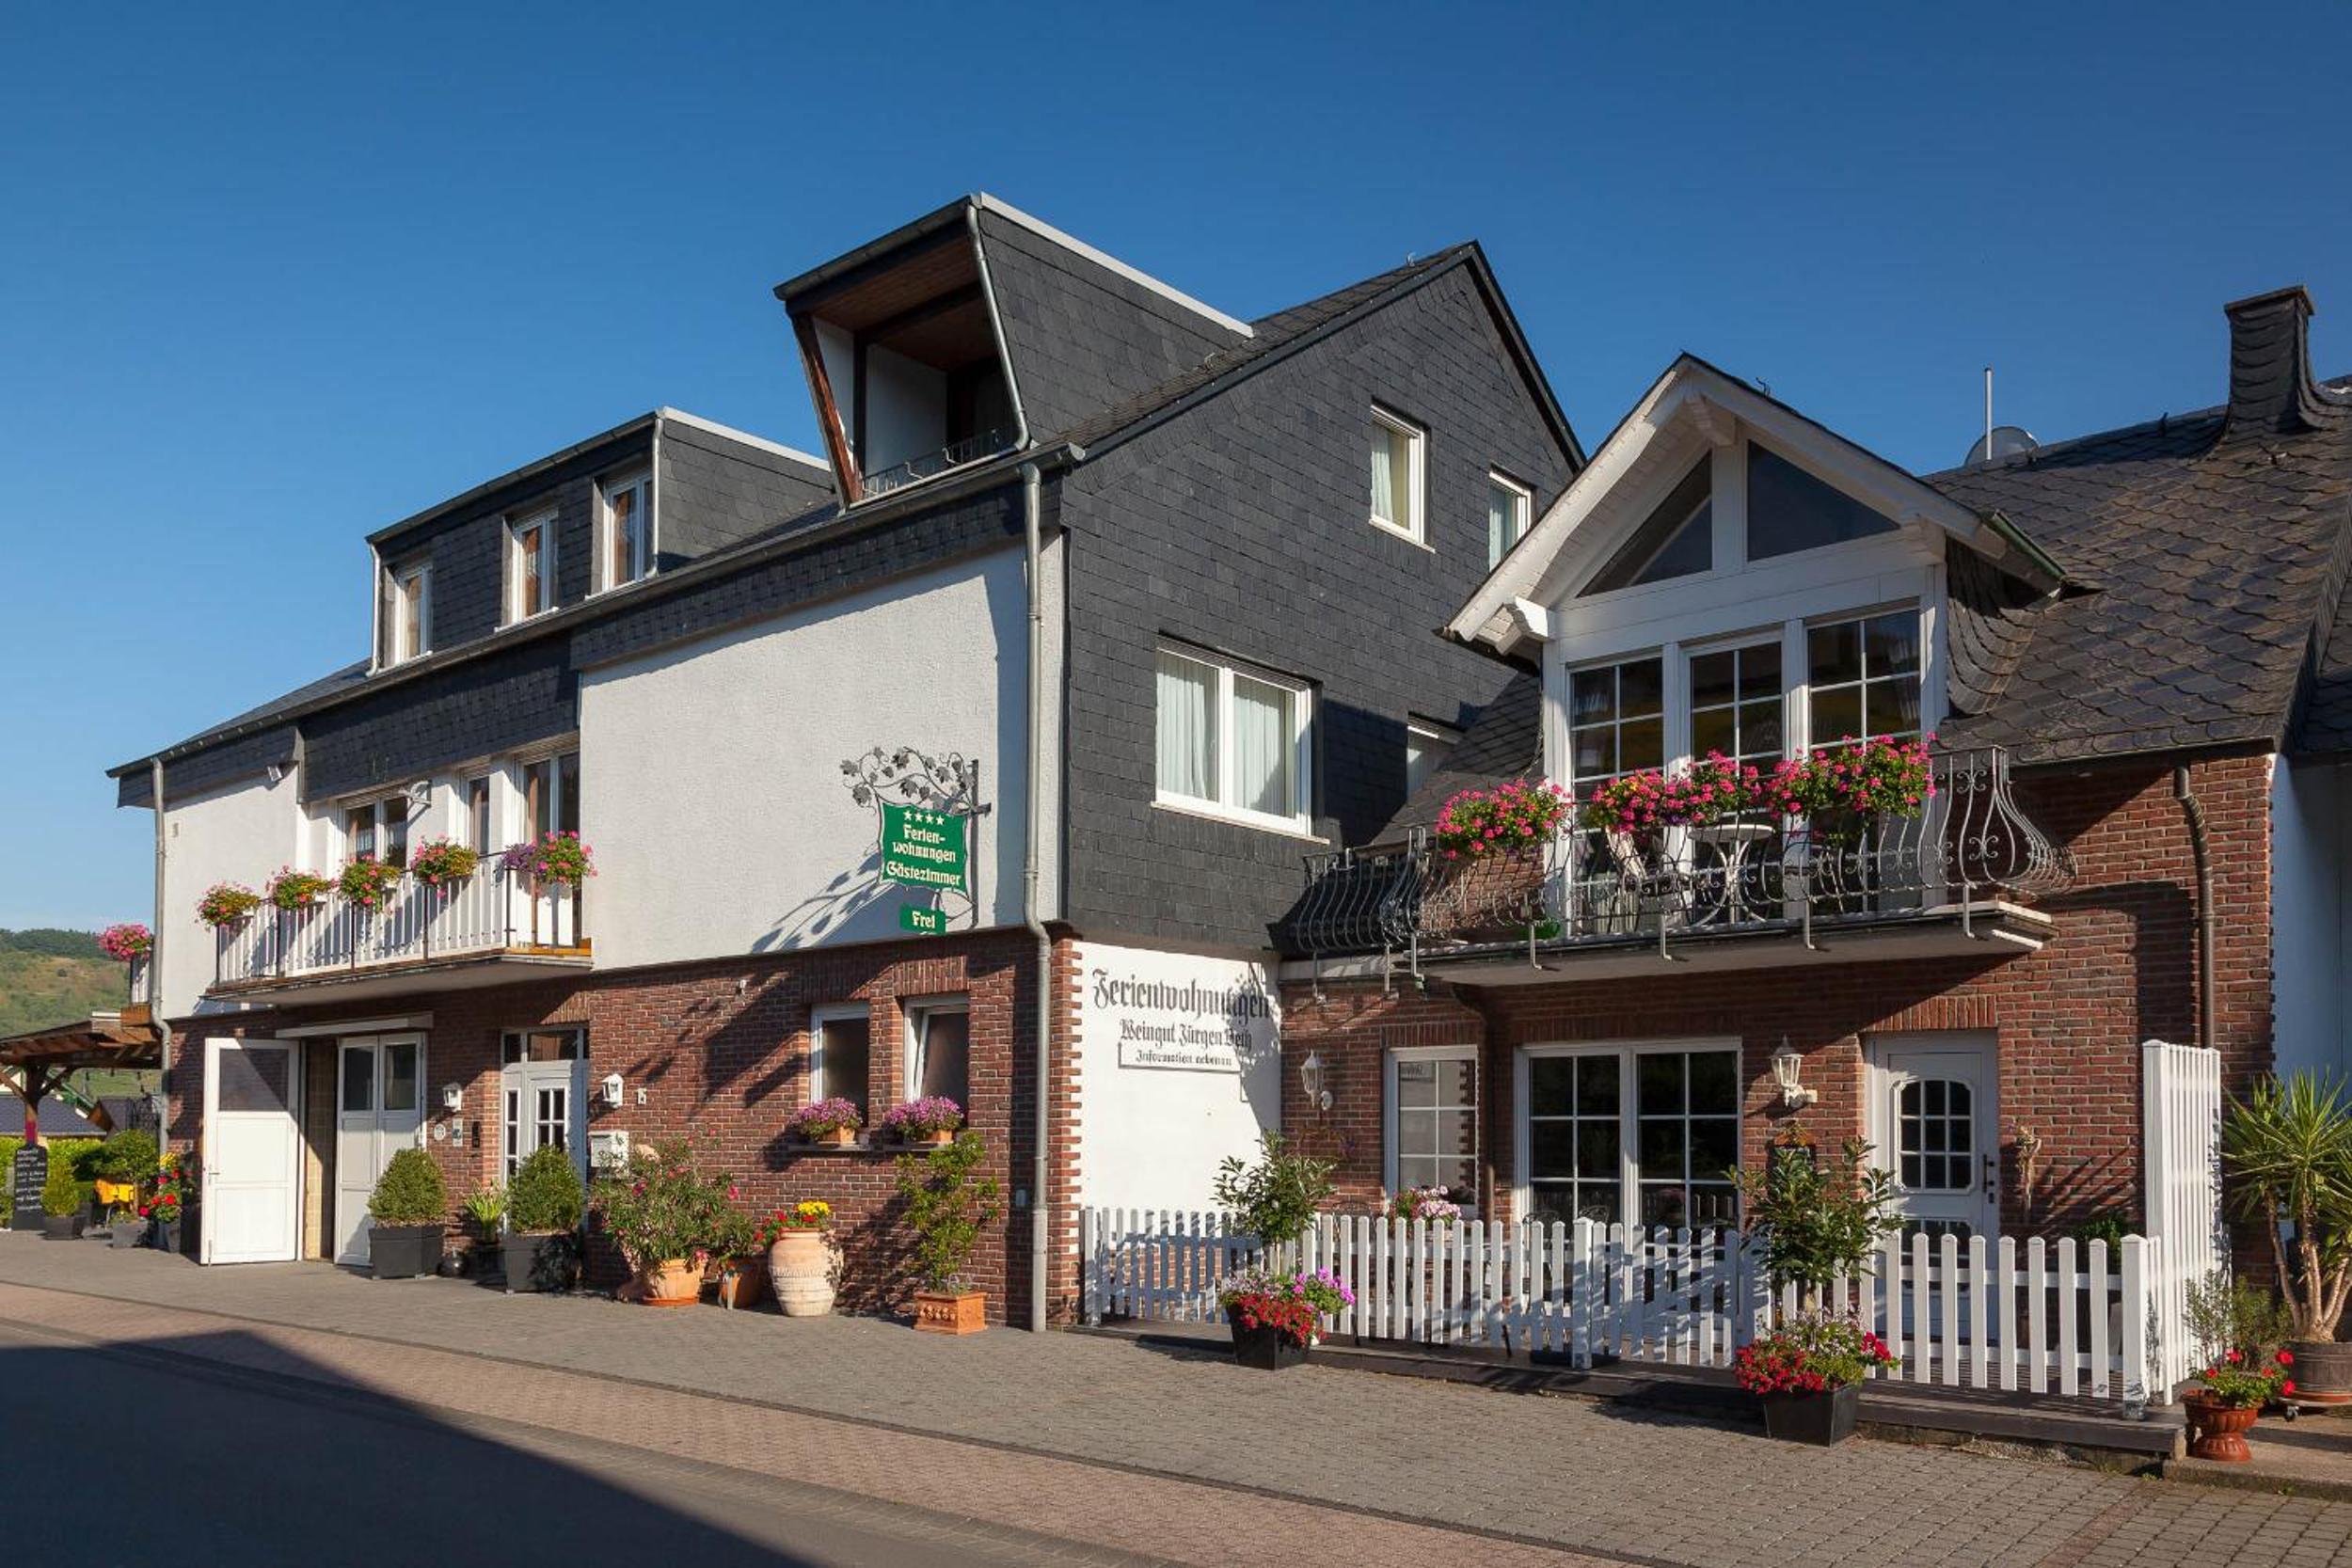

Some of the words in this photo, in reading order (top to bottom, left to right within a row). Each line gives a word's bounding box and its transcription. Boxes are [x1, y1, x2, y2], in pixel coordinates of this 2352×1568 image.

[903, 823, 946, 844] Ferien-
[893, 841, 956, 863] wohnungen
[886, 861, 961, 885] Gästezimmer
[912, 911, 935, 928] Frei
[1092, 968, 1270, 1026] Ferienwohnungen
[1120, 1019, 1176, 1049] Weingut
[1179, 1023, 1222, 1050] Jürgen
